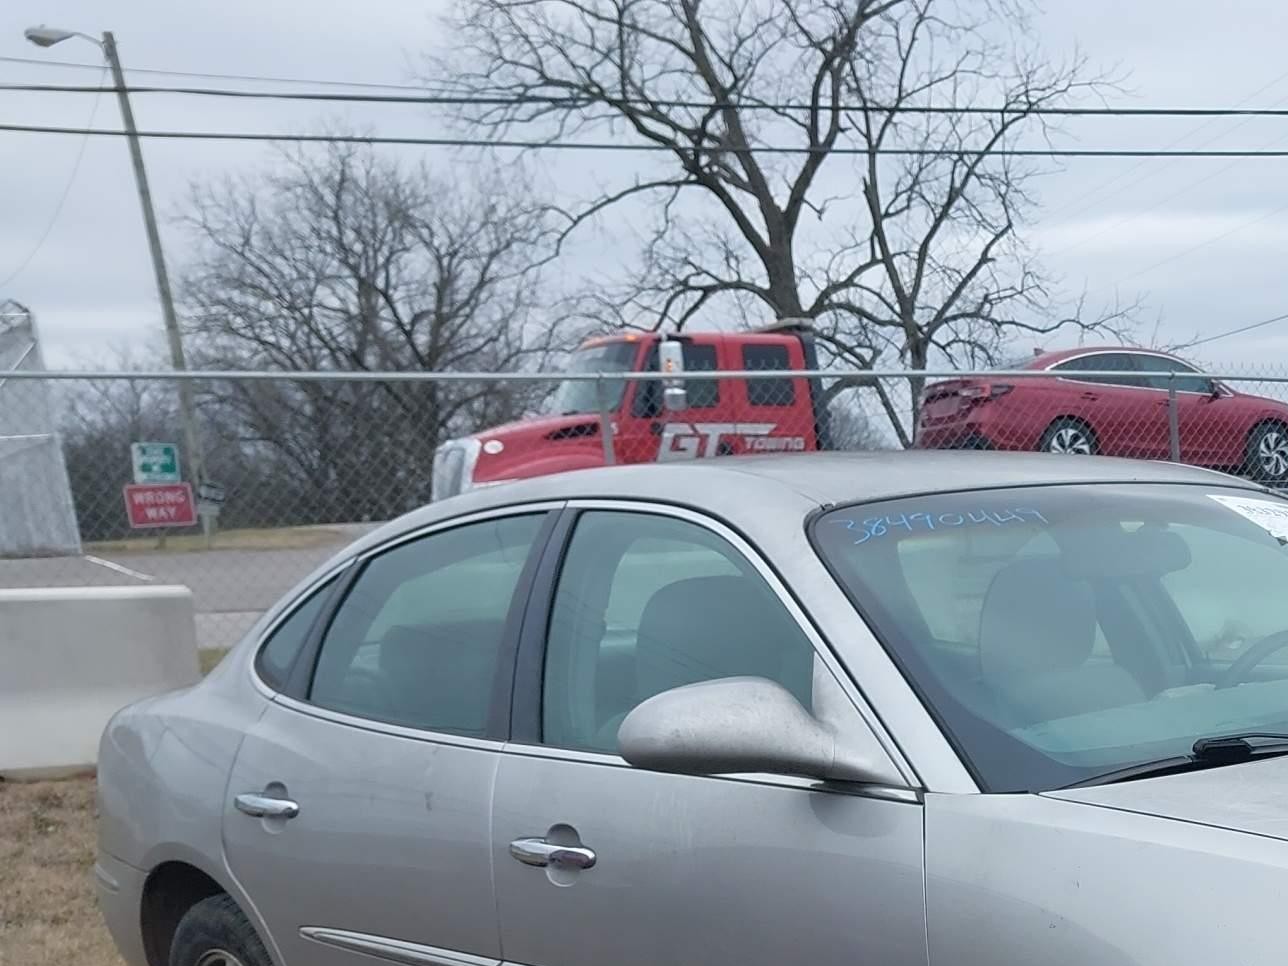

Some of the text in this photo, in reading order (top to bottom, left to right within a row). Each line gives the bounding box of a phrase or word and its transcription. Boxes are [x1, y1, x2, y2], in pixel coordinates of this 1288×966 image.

[132, 491, 187, 505] WRONG
[144, 507, 178, 520] WAY
[828, 506, 1049, 546] 38490449
